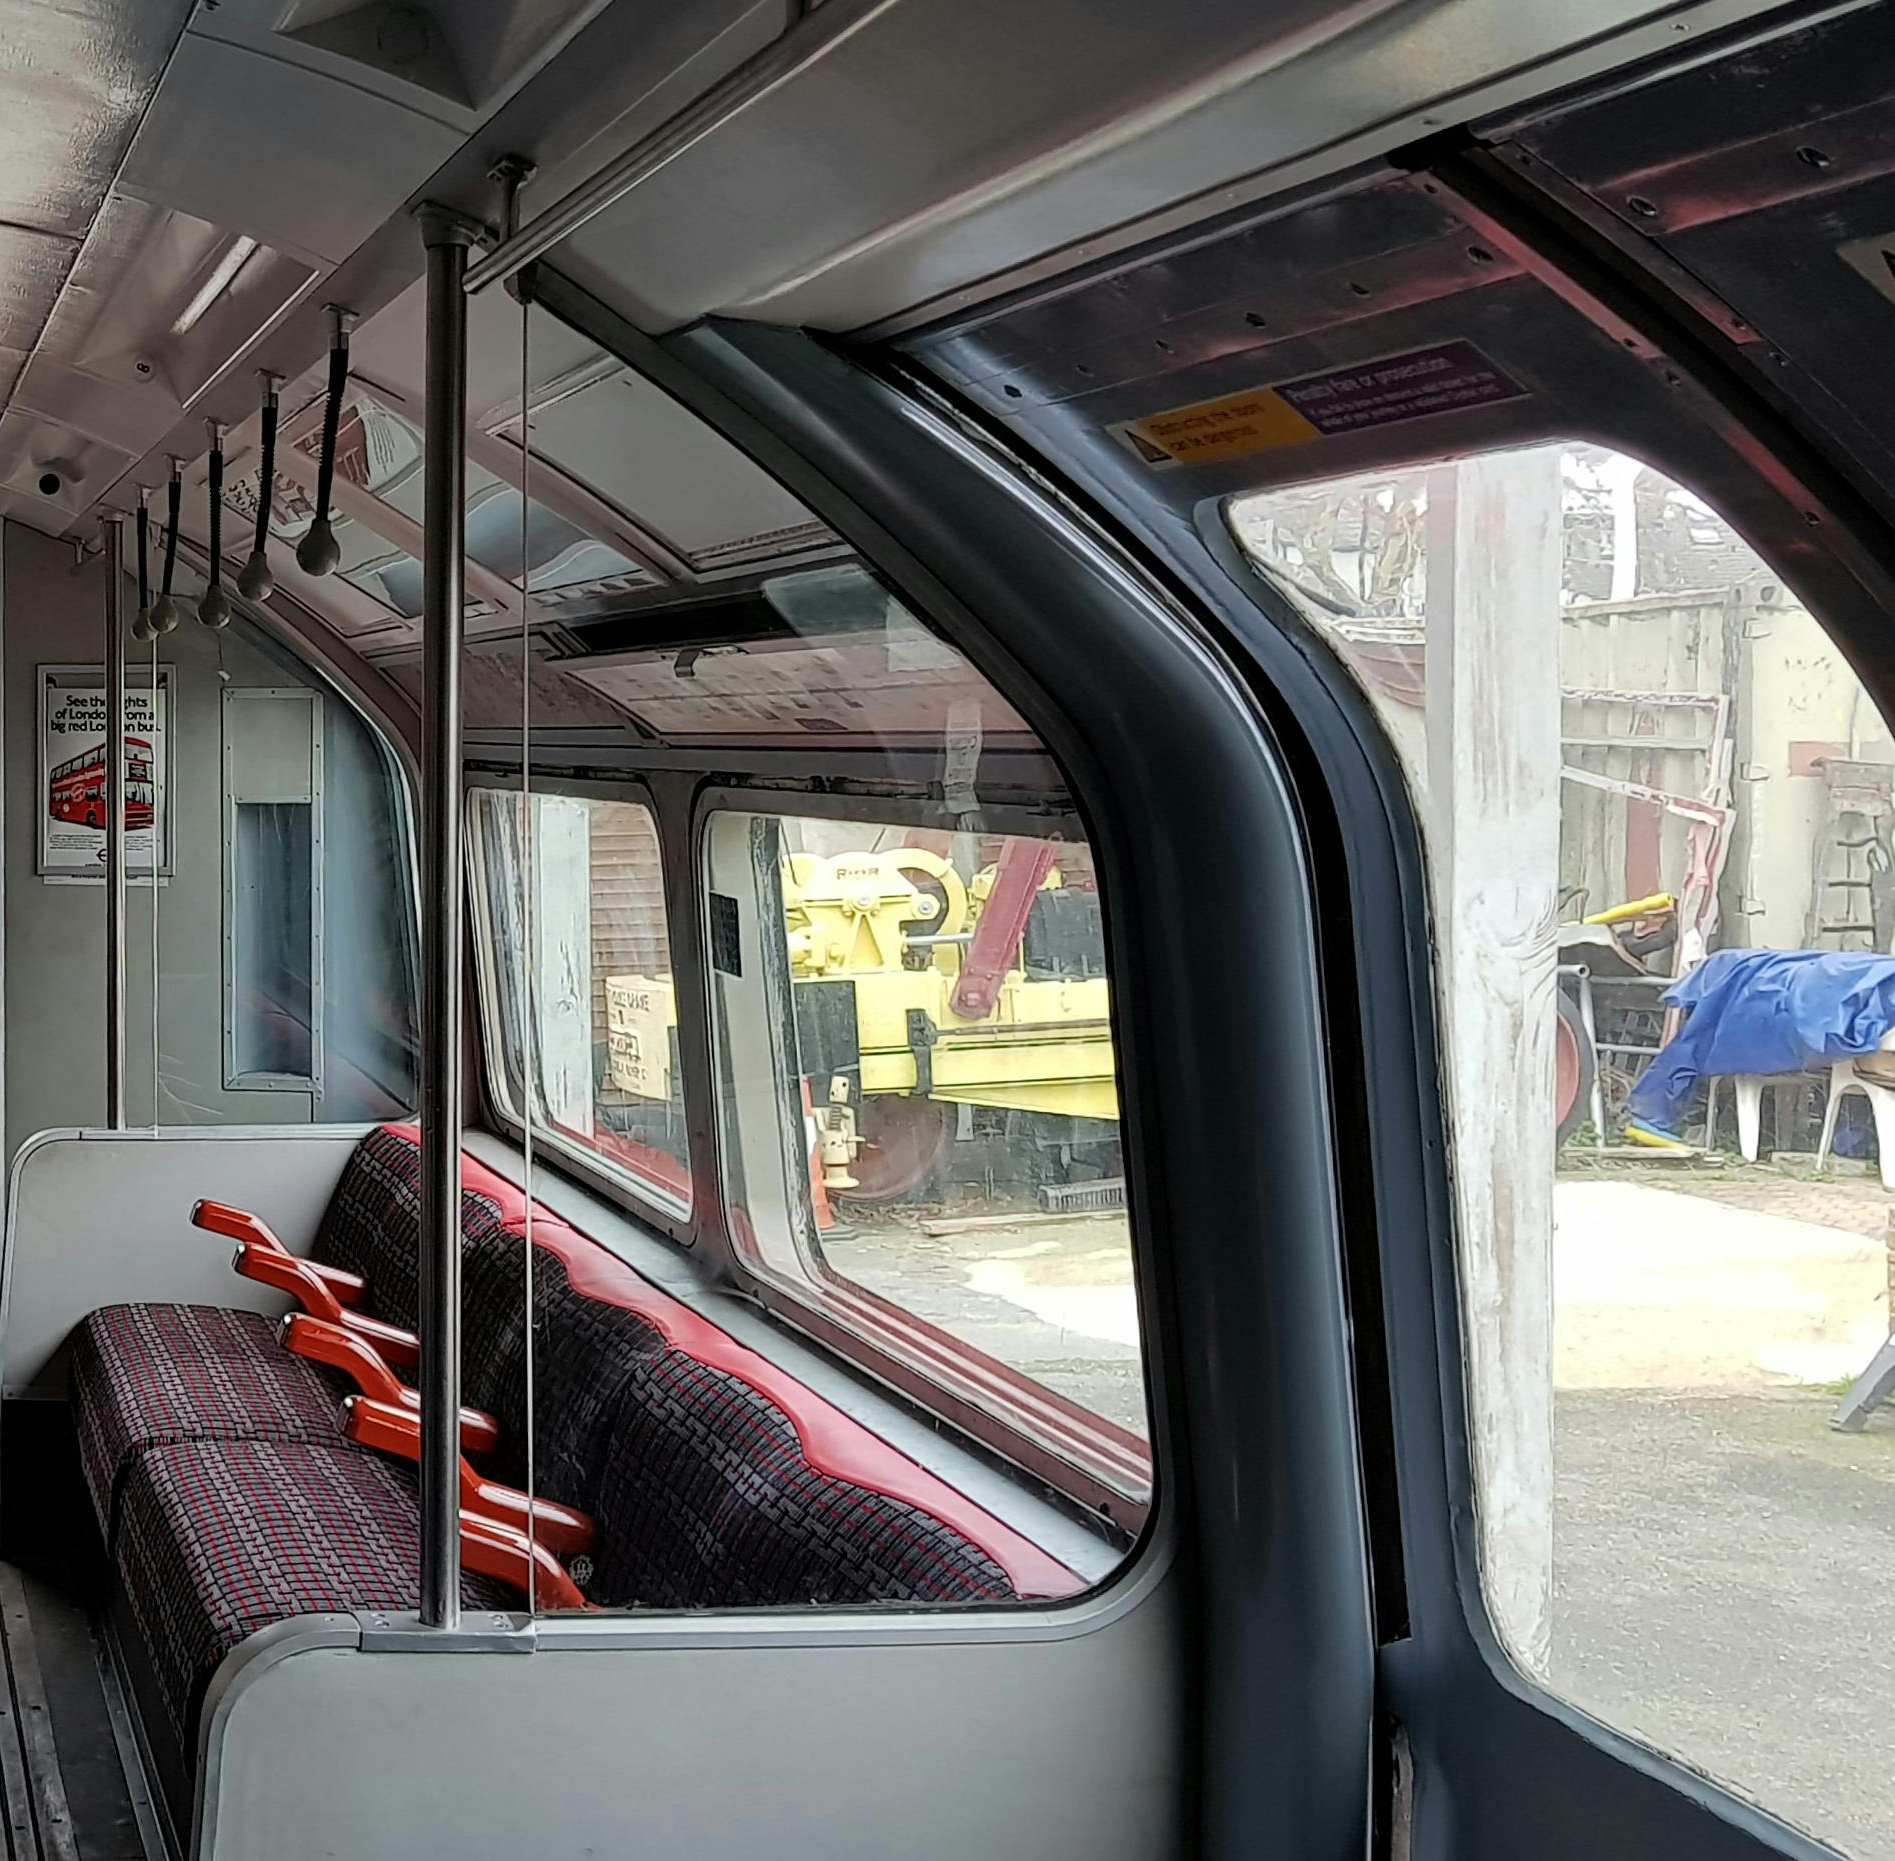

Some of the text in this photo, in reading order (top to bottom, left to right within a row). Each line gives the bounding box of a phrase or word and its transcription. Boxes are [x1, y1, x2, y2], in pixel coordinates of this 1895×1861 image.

[66, 694, 88, 707] See
[55, 708, 68, 719] of
[69, 708, 106, 720] Londo
[51, 720, 66, 734] big
[68, 721, 87, 732] red
